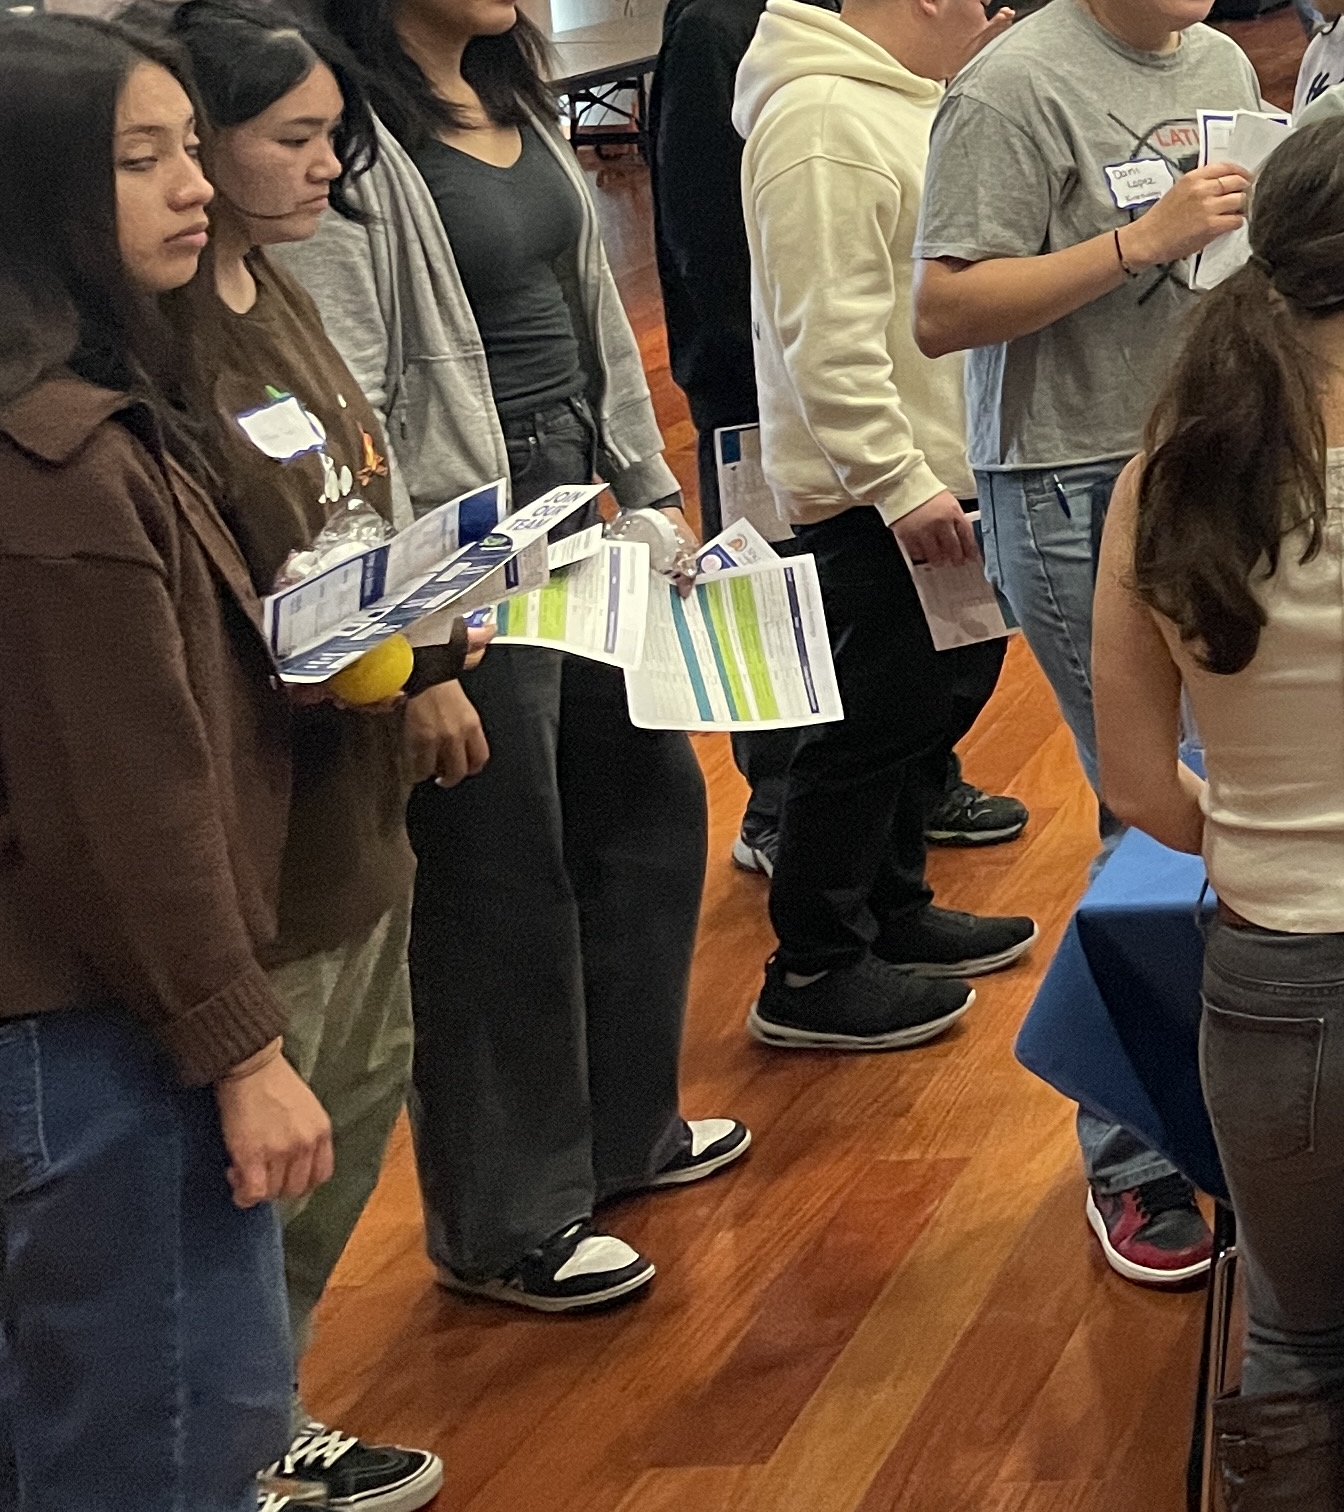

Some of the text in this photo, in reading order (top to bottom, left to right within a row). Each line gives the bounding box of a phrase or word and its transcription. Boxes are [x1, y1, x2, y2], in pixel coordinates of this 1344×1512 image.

[543, 491, 587, 504] JOIN
[531, 505, 569, 517] OUR
[506, 518, 553, 531] TEAM
